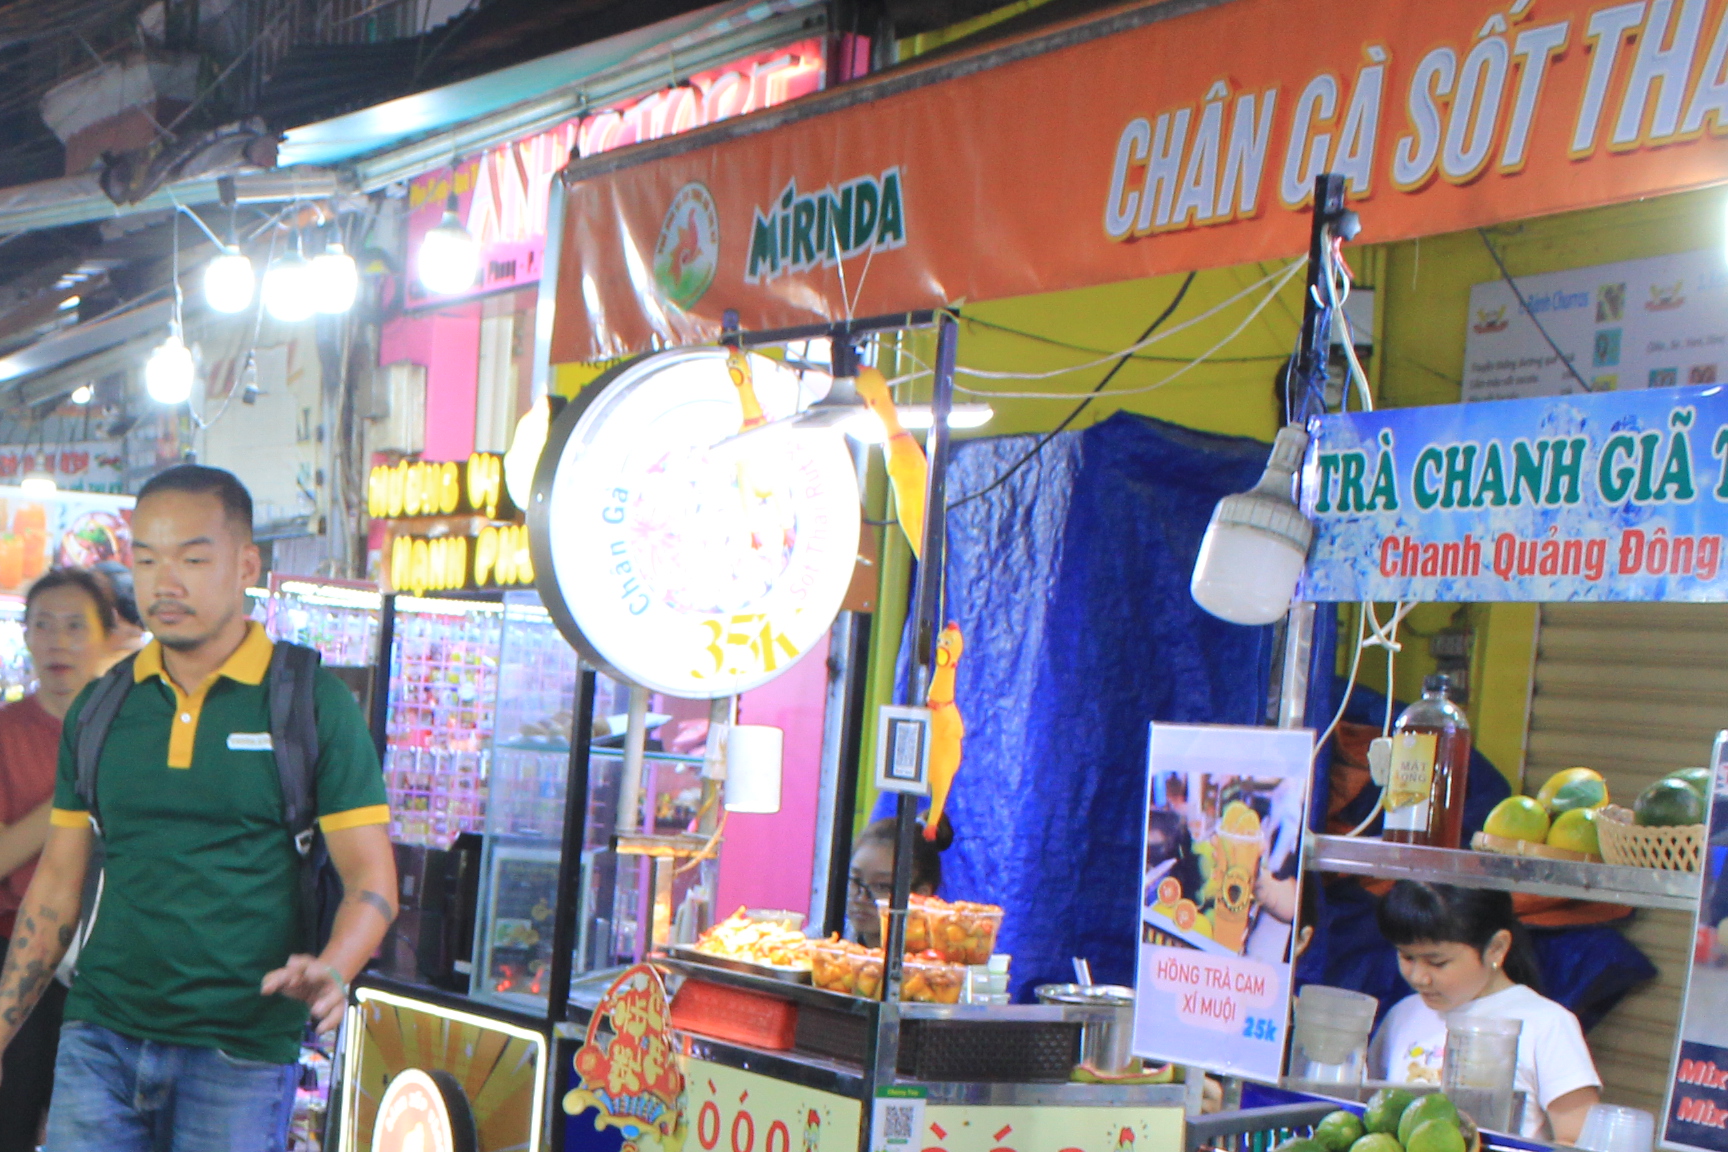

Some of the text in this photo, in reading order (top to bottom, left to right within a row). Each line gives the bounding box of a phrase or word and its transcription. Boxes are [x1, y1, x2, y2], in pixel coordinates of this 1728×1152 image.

[1105, 80, 1276, 239] CHÂN
[1281, 45, 1387, 208] GÀ
[1390, 0, 1570, 191] SỐT
[1315, 430, 1399, 512] TRÀ
[1413, 436, 1587, 511] CHANH
[1598, 406, 1695, 505] GIÃ
[1379, 525, 1721, 581] Chanh Quảng Đông
[1157, 957, 1265, 996] HỒNG TRÀ CAM
[1182, 991, 1237, 1023] XÍ MUỘI
[1243, 1016, 1277, 1042] 25k
